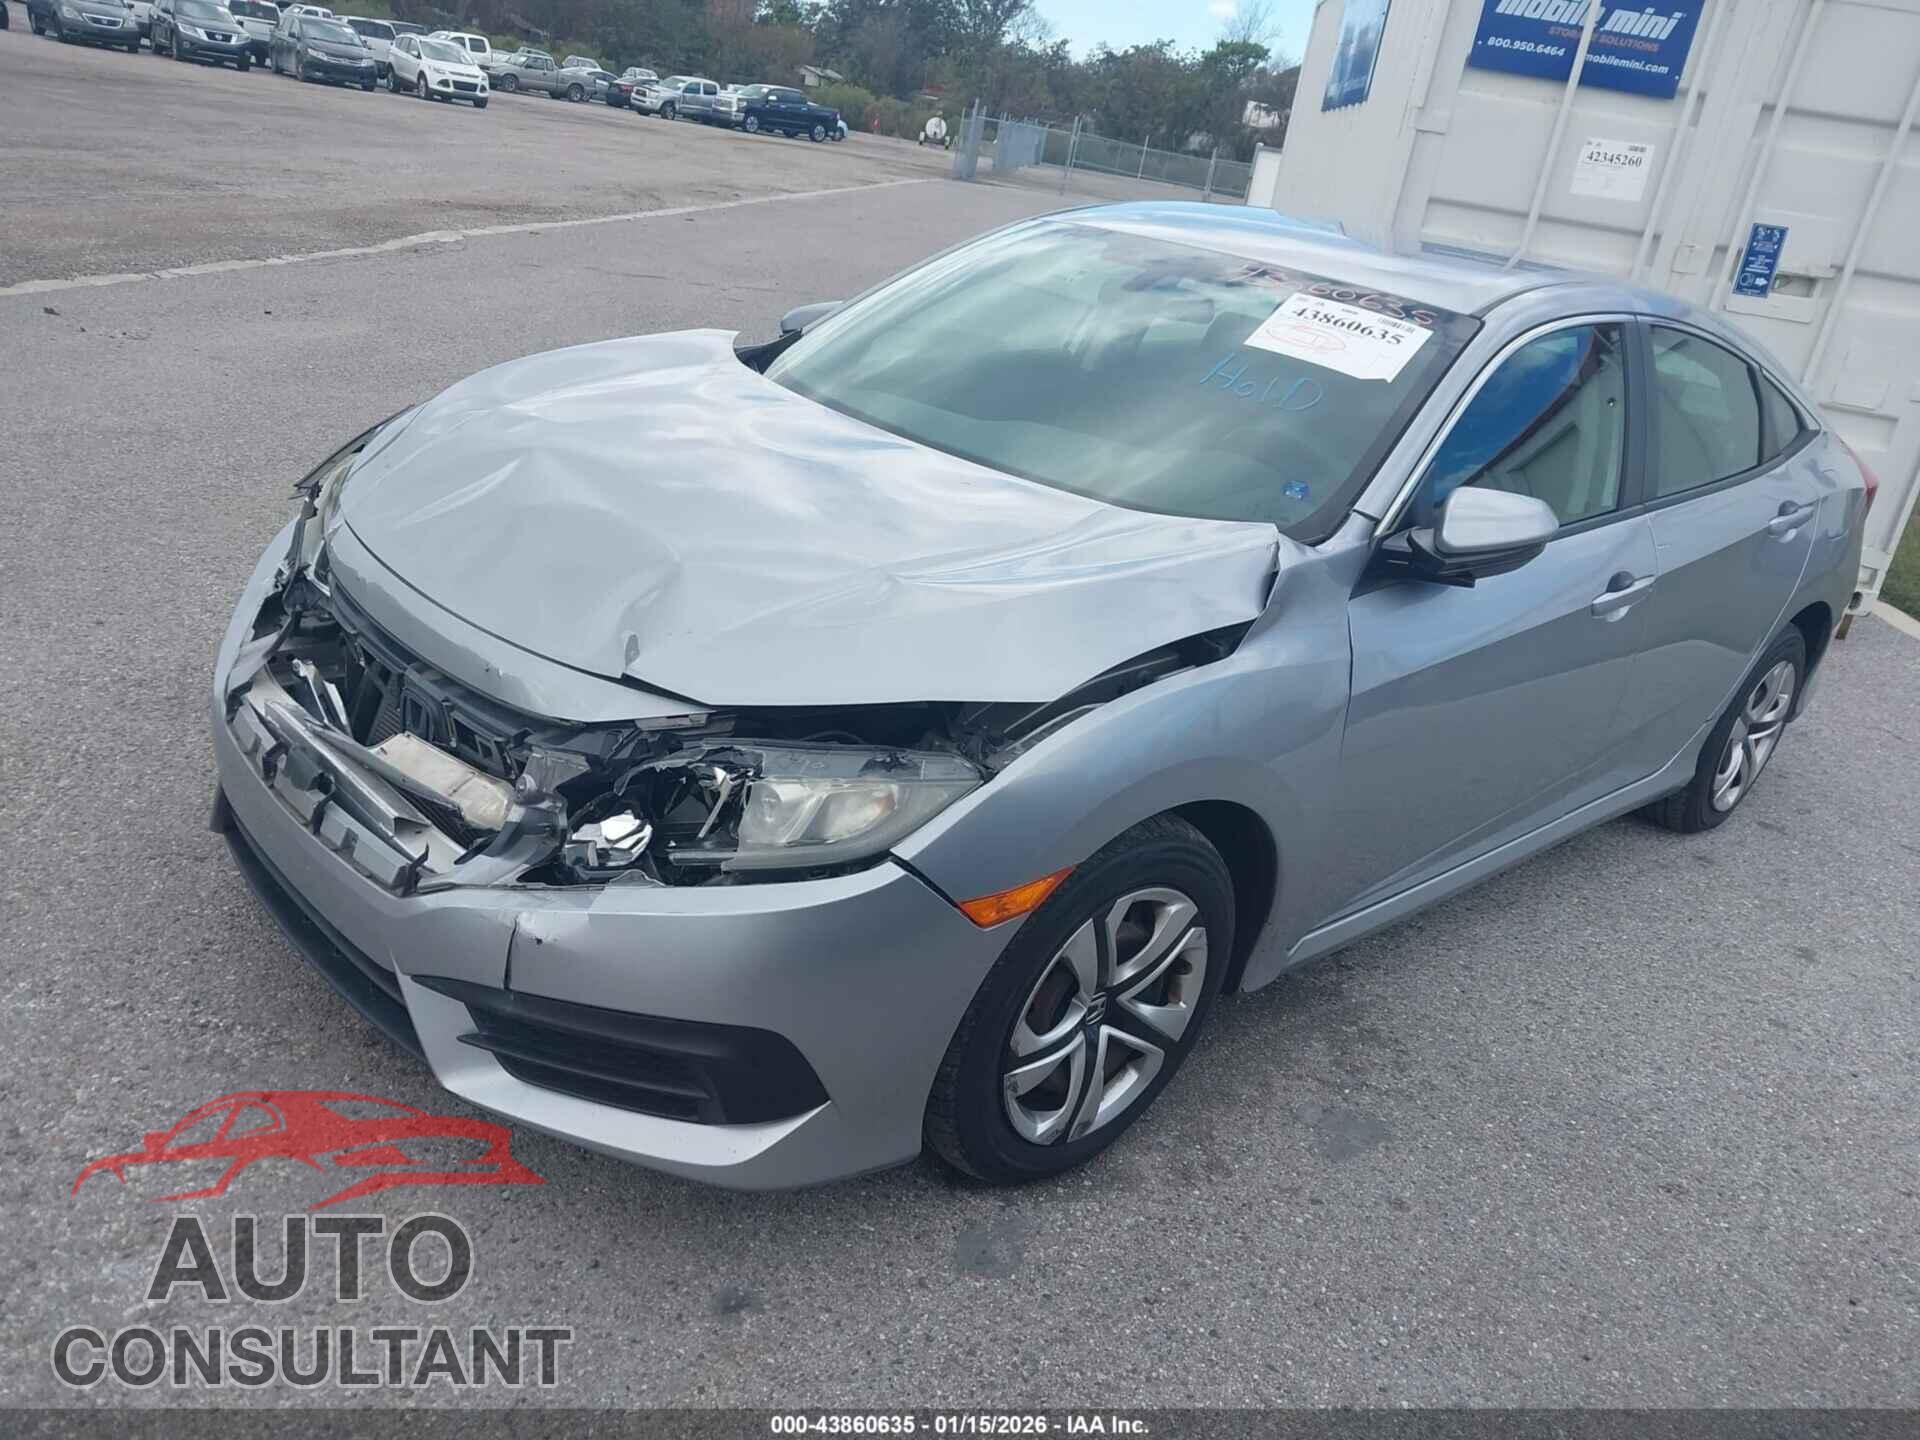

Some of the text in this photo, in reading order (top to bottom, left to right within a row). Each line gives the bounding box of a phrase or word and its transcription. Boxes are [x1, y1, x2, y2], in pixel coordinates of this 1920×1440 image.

[1487, 36, 1567, 57] 800.950.6464
[1585, 52, 1670, 75] mobilemini.com
[1585, 150, 1643, 168] 42345260
[1291, 305, 1406, 346] 43860635
